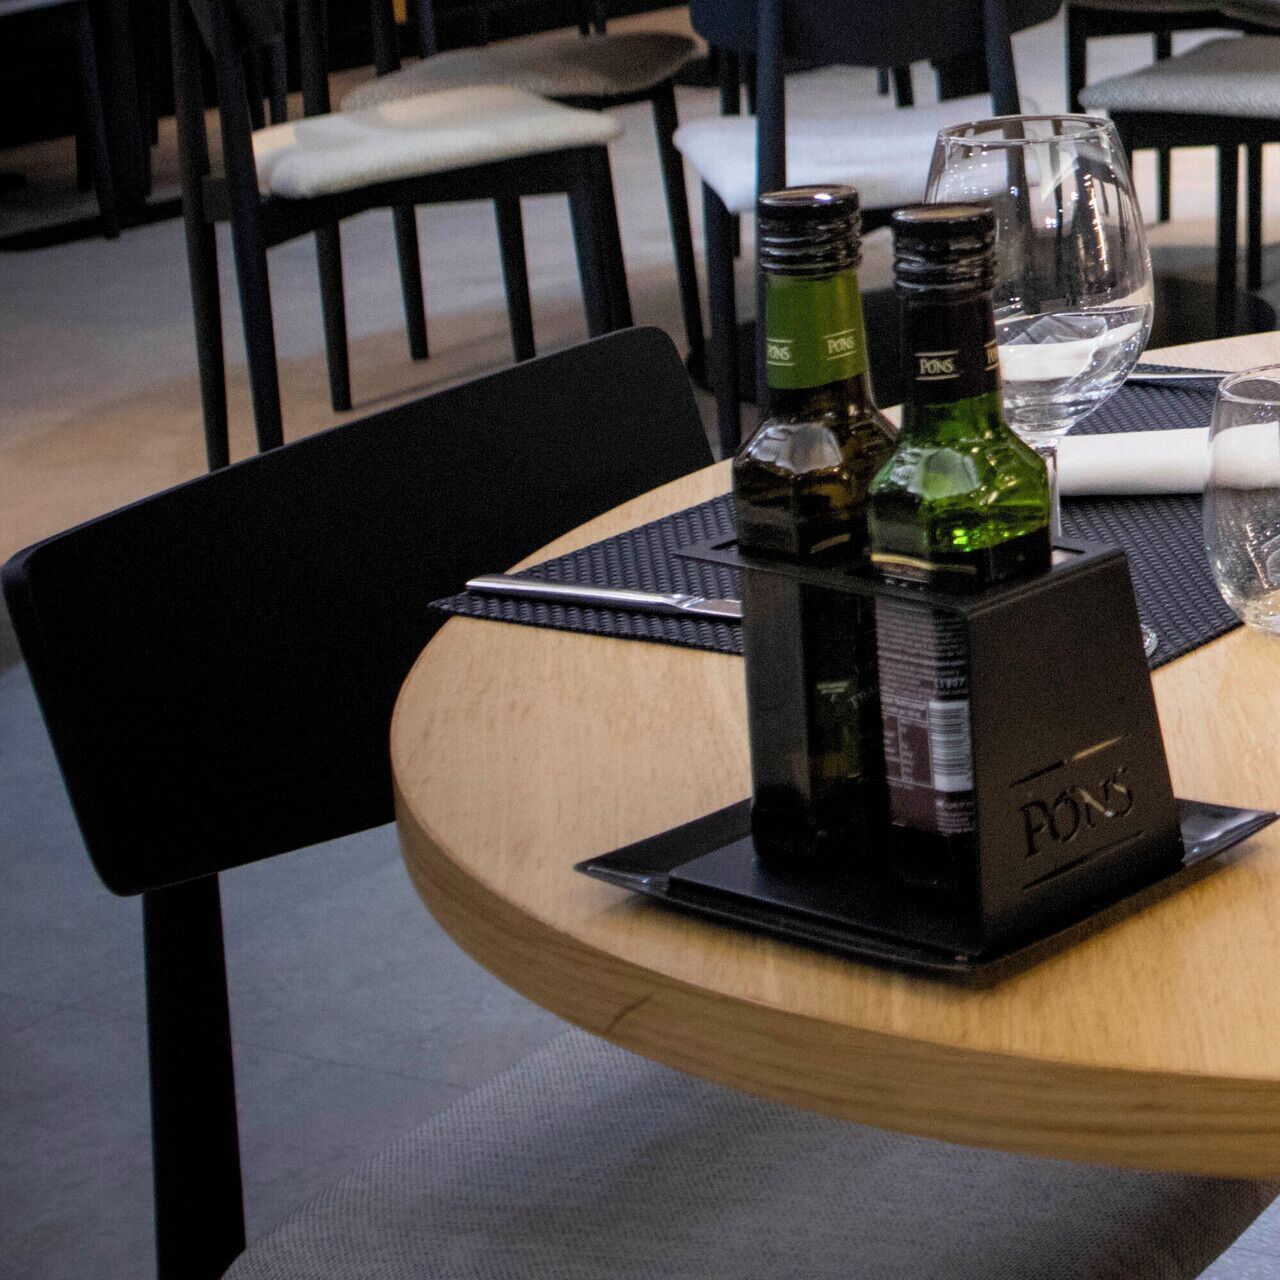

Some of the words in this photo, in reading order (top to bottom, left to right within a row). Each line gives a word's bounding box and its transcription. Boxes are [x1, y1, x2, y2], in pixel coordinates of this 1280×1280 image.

[827, 337, 855, 354] PONS
[919, 357, 955, 375] PONS
[1019, 767, 1133, 860] PONS
